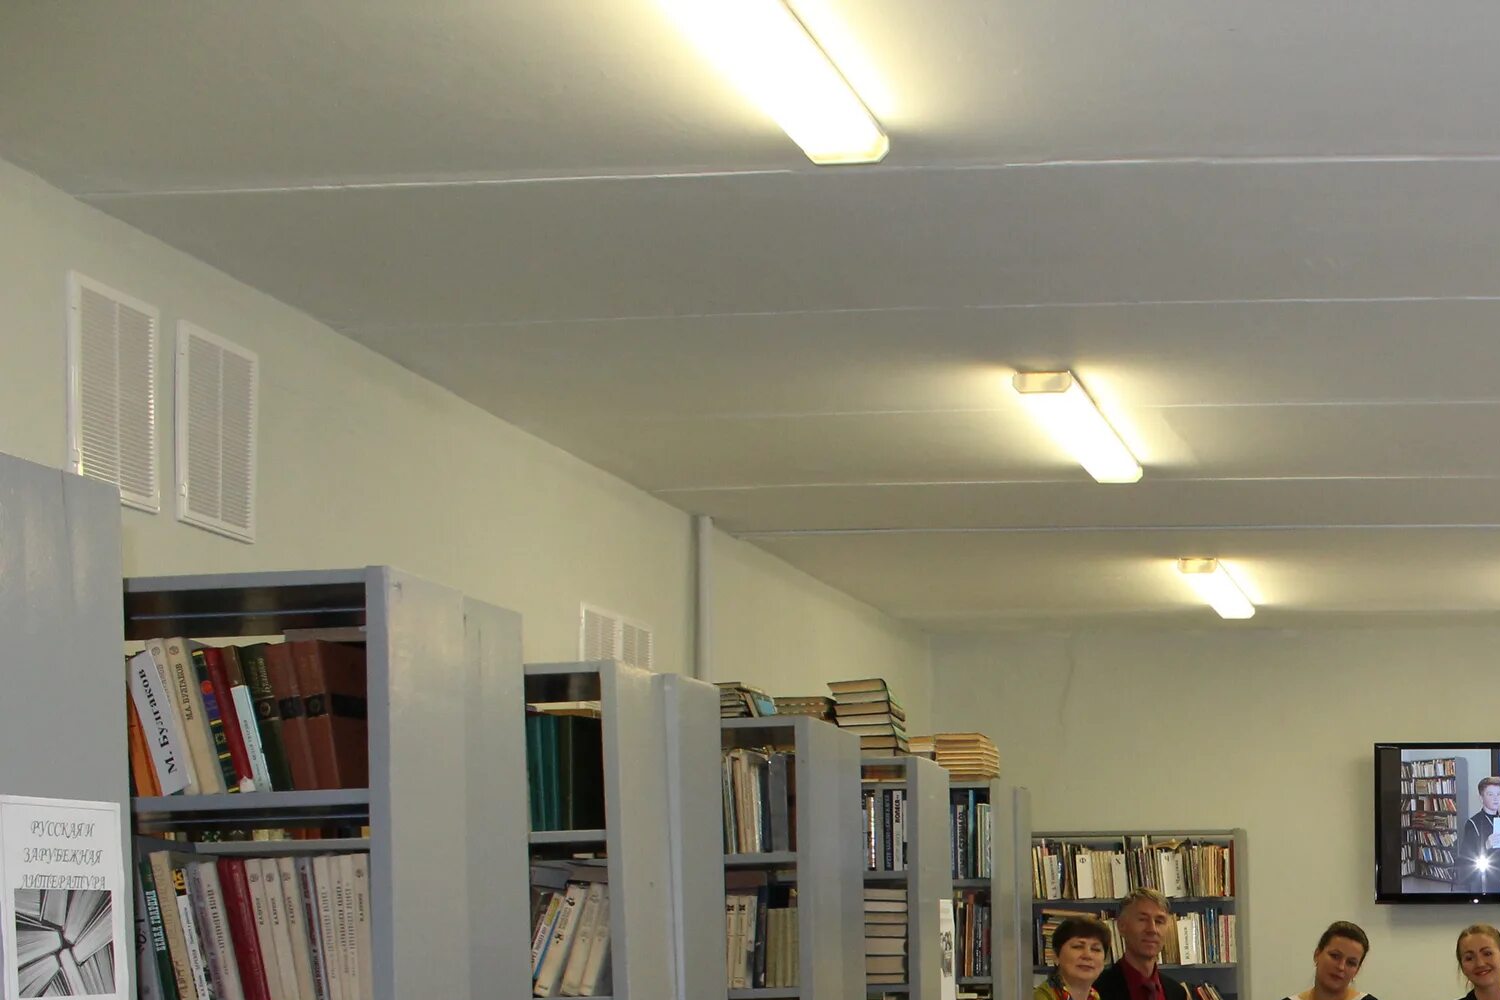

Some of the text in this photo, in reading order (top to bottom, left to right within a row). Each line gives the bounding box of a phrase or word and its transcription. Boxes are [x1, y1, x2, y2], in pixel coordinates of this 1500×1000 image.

[139, 668, 171, 748] Булгаков
[162, 750, 178, 775] М.
[31, 821, 85, 838] РУССКАЯ
[24, 847, 103, 865] ЗАРУБЕЖНАЯ
[20, 874, 106, 890] ЛИТЕРАТУРА
